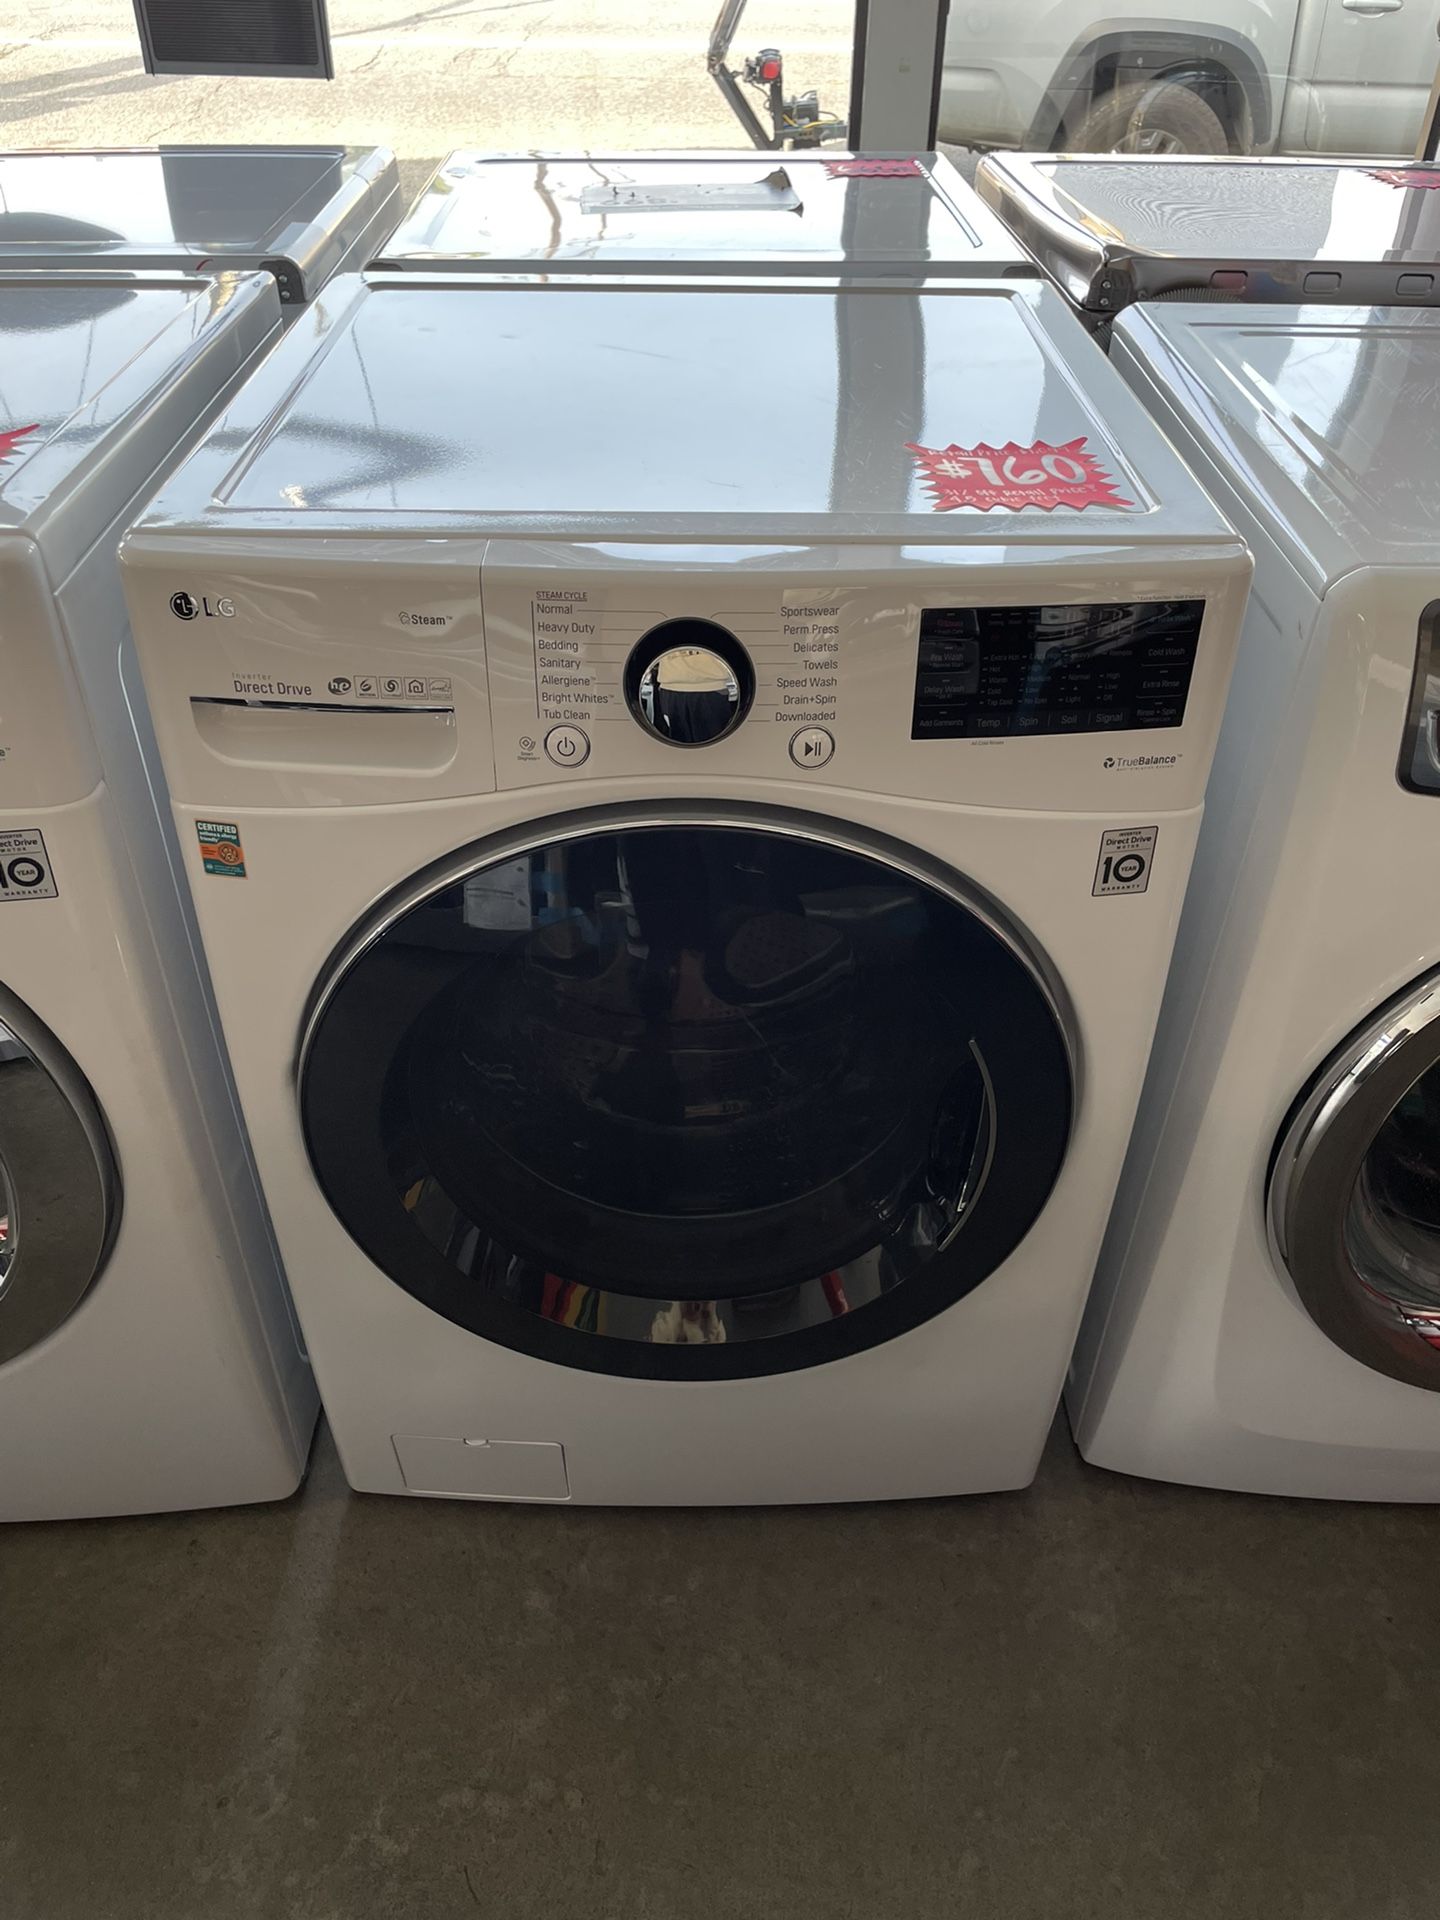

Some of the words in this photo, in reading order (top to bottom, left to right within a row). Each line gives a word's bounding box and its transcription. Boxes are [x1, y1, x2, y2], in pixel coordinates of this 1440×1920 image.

[935, 455, 1087, 486] $760
[536, 591, 563, 600] STEAM
[564, 591, 588, 601] CYCLE
[202, 597, 236, 618] LG
[536, 603, 573, 614] Normal
[780, 606, 840, 619] Sportswear
[537, 622, 570, 634] Heavy
[571, 622, 596, 635] Duty
[812, 624, 840, 634] Press
[538, 640, 579, 653] Bedding
[793, 642, 839, 653] Delicates
[1148, 648, 1165, 657] Cold
[1166, 647, 1186, 656] Wash
[539, 657, 581, 670] Sanitary
[803, 659, 839, 670] Towels
[231, 672, 272, 681] Inverter
[233, 680, 274, 694] Direct
[277, 682, 312, 696] Drive
[776, 678, 807, 689] Speed
[809, 677, 838, 687] Wash
[1142, 681, 1161, 689] Extra
[1162, 679, 1180, 688] Rinse
[945, 685, 965, 694] Wash
[541, 692, 572, 704] Bright
[783, 694, 837, 706] Drain+Spin
[543, 709, 561, 720] Tub
[563, 709, 591, 720] Clean
[775, 711, 836, 722] Downloaded
[1061, 714, 1078, 724] Soil
[1096, 712, 1124, 724] Signal
[976, 718, 1001, 728] Temp
[1019, 717, 1039, 728] Spin
[197, 822, 237, 834] CERTIFIED
[13, 839, 38, 847] Drive
[1105, 837, 1130, 846] Direct
[1130, 836, 1152, 844] Drive
[16, 869, 37, 877] YEAR
[1102, 853, 1146, 884] 10
[4, 888, 49, 896] WARRANTY
